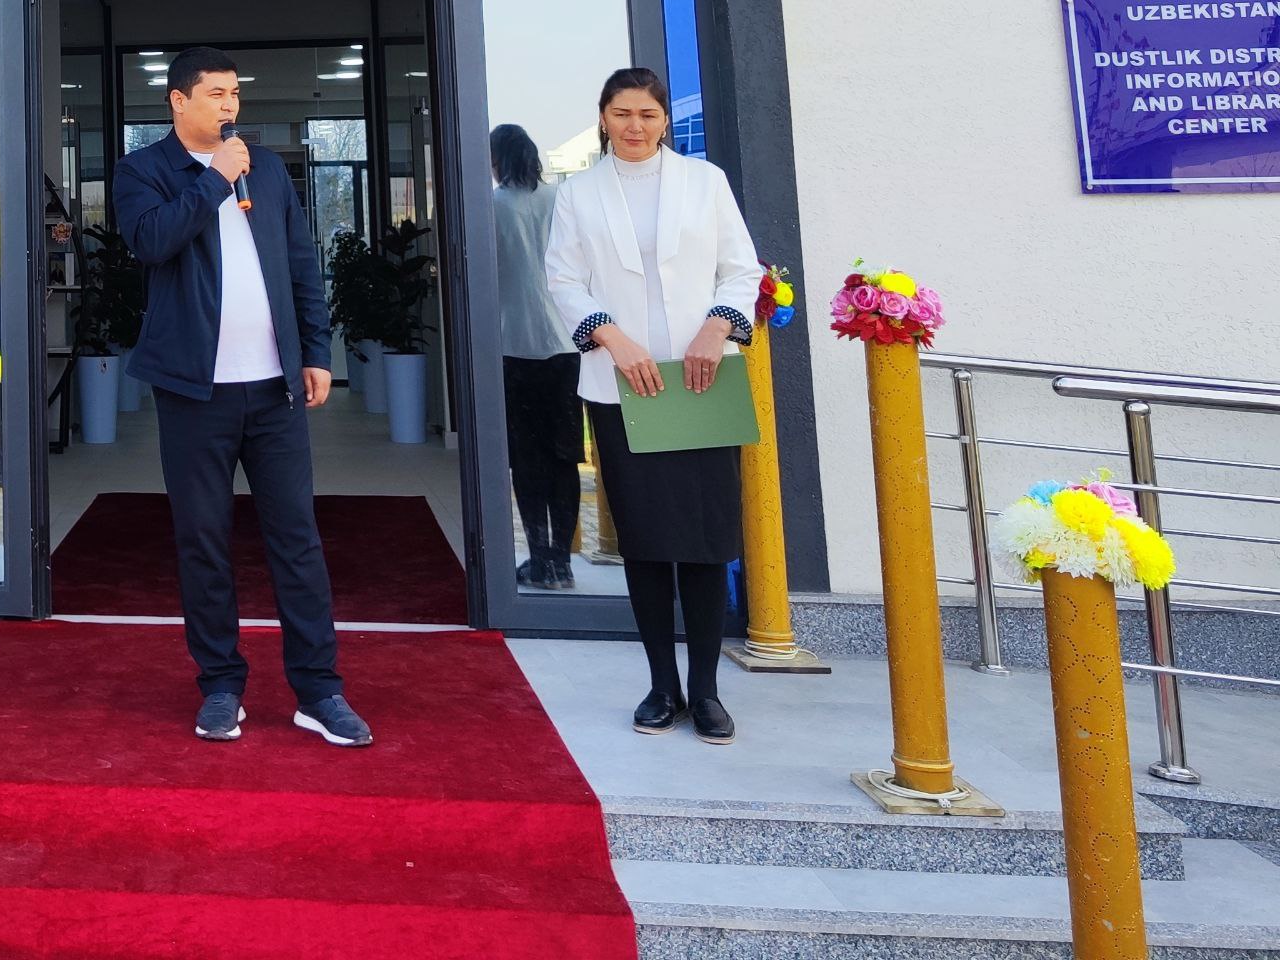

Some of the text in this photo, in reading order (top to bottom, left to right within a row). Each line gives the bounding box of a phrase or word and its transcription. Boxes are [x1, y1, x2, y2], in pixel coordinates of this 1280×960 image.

[1126, 1, 1280, 21] UZBEKISTAN
[1094, 49, 1203, 67] DUSTLIK
[1131, 95, 1184, 112] AND
[1167, 117, 1268, 135] CENTER
